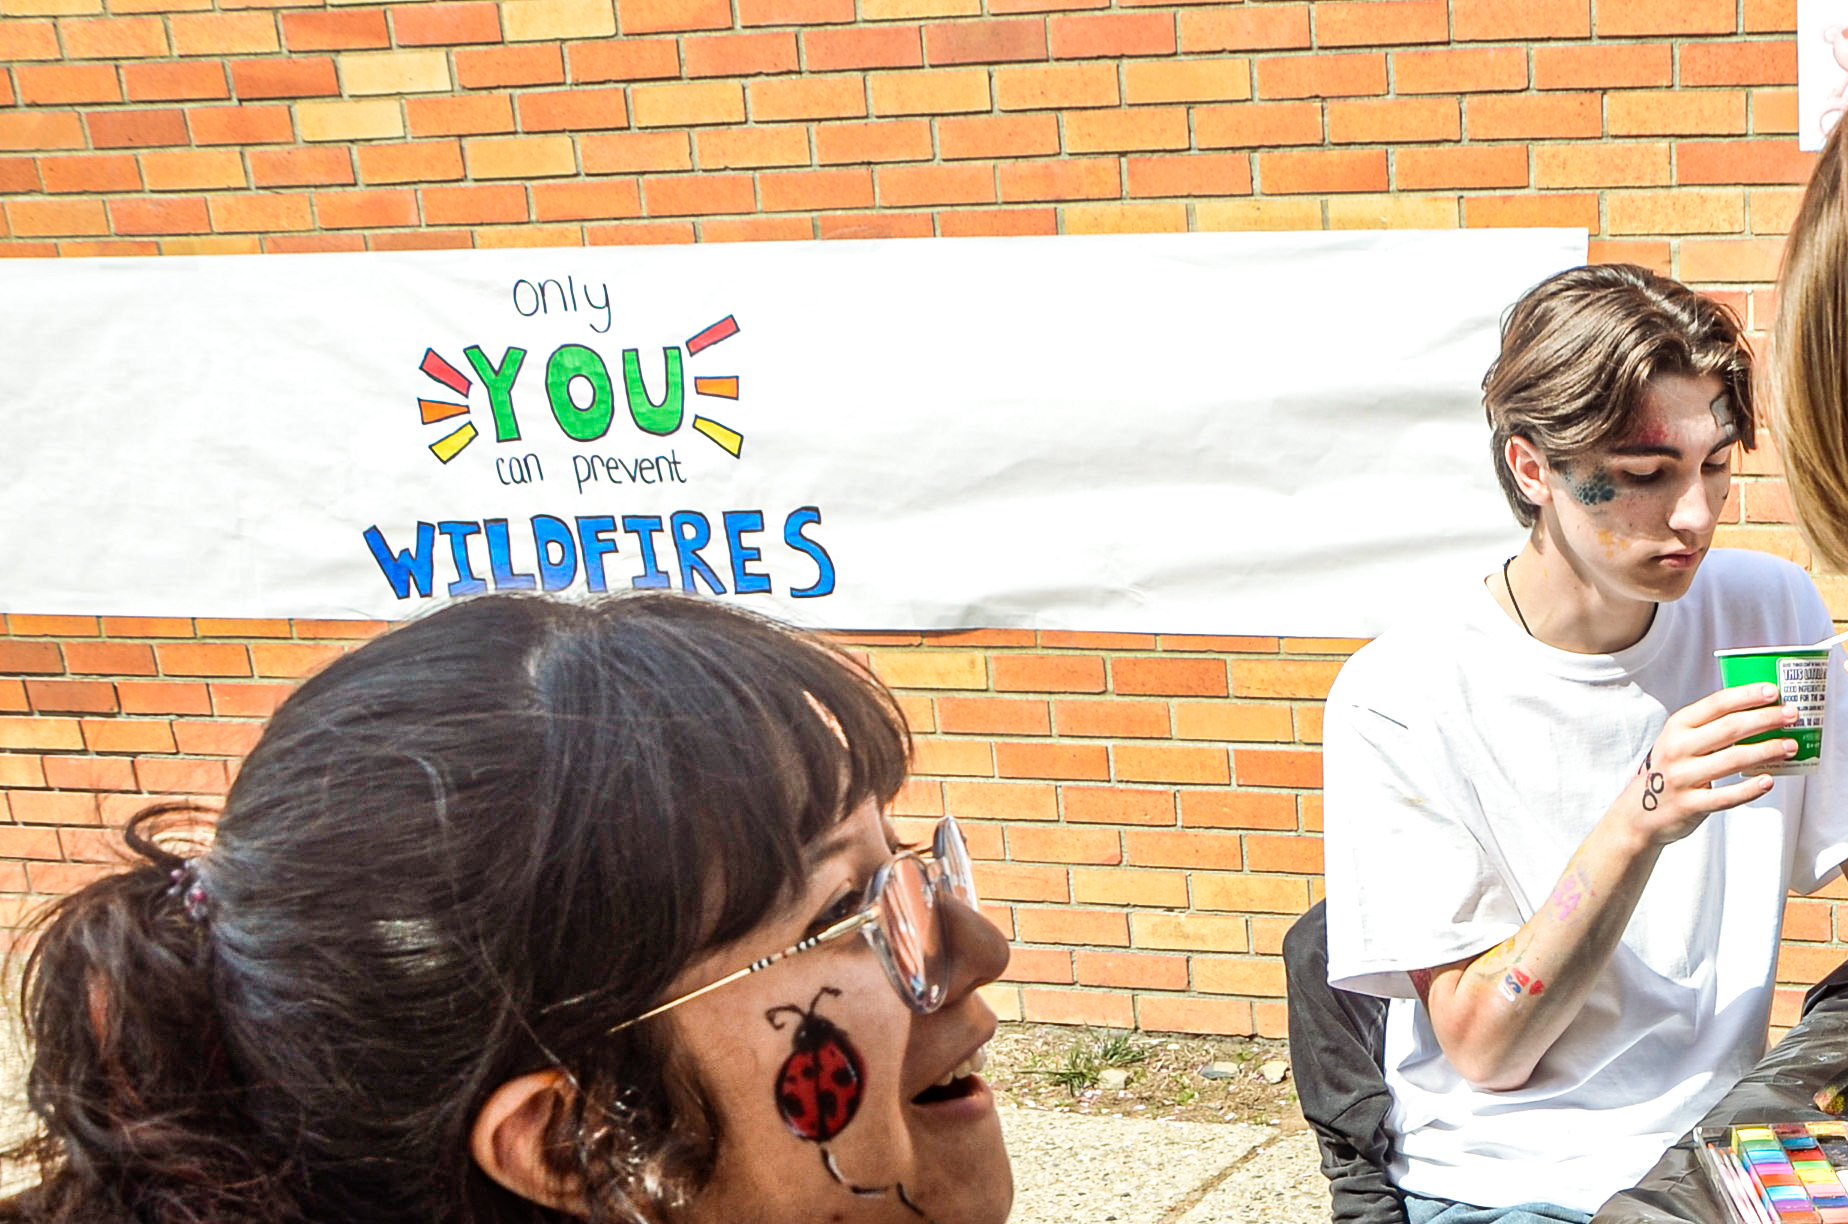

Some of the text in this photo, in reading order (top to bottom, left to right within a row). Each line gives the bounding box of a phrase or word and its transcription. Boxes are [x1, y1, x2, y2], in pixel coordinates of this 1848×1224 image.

[513, 275, 612, 333] only
[463, 343, 685, 443] YOU
[496, 449, 687, 494] can prevent
[363, 505, 836, 599] WILDFIRES
